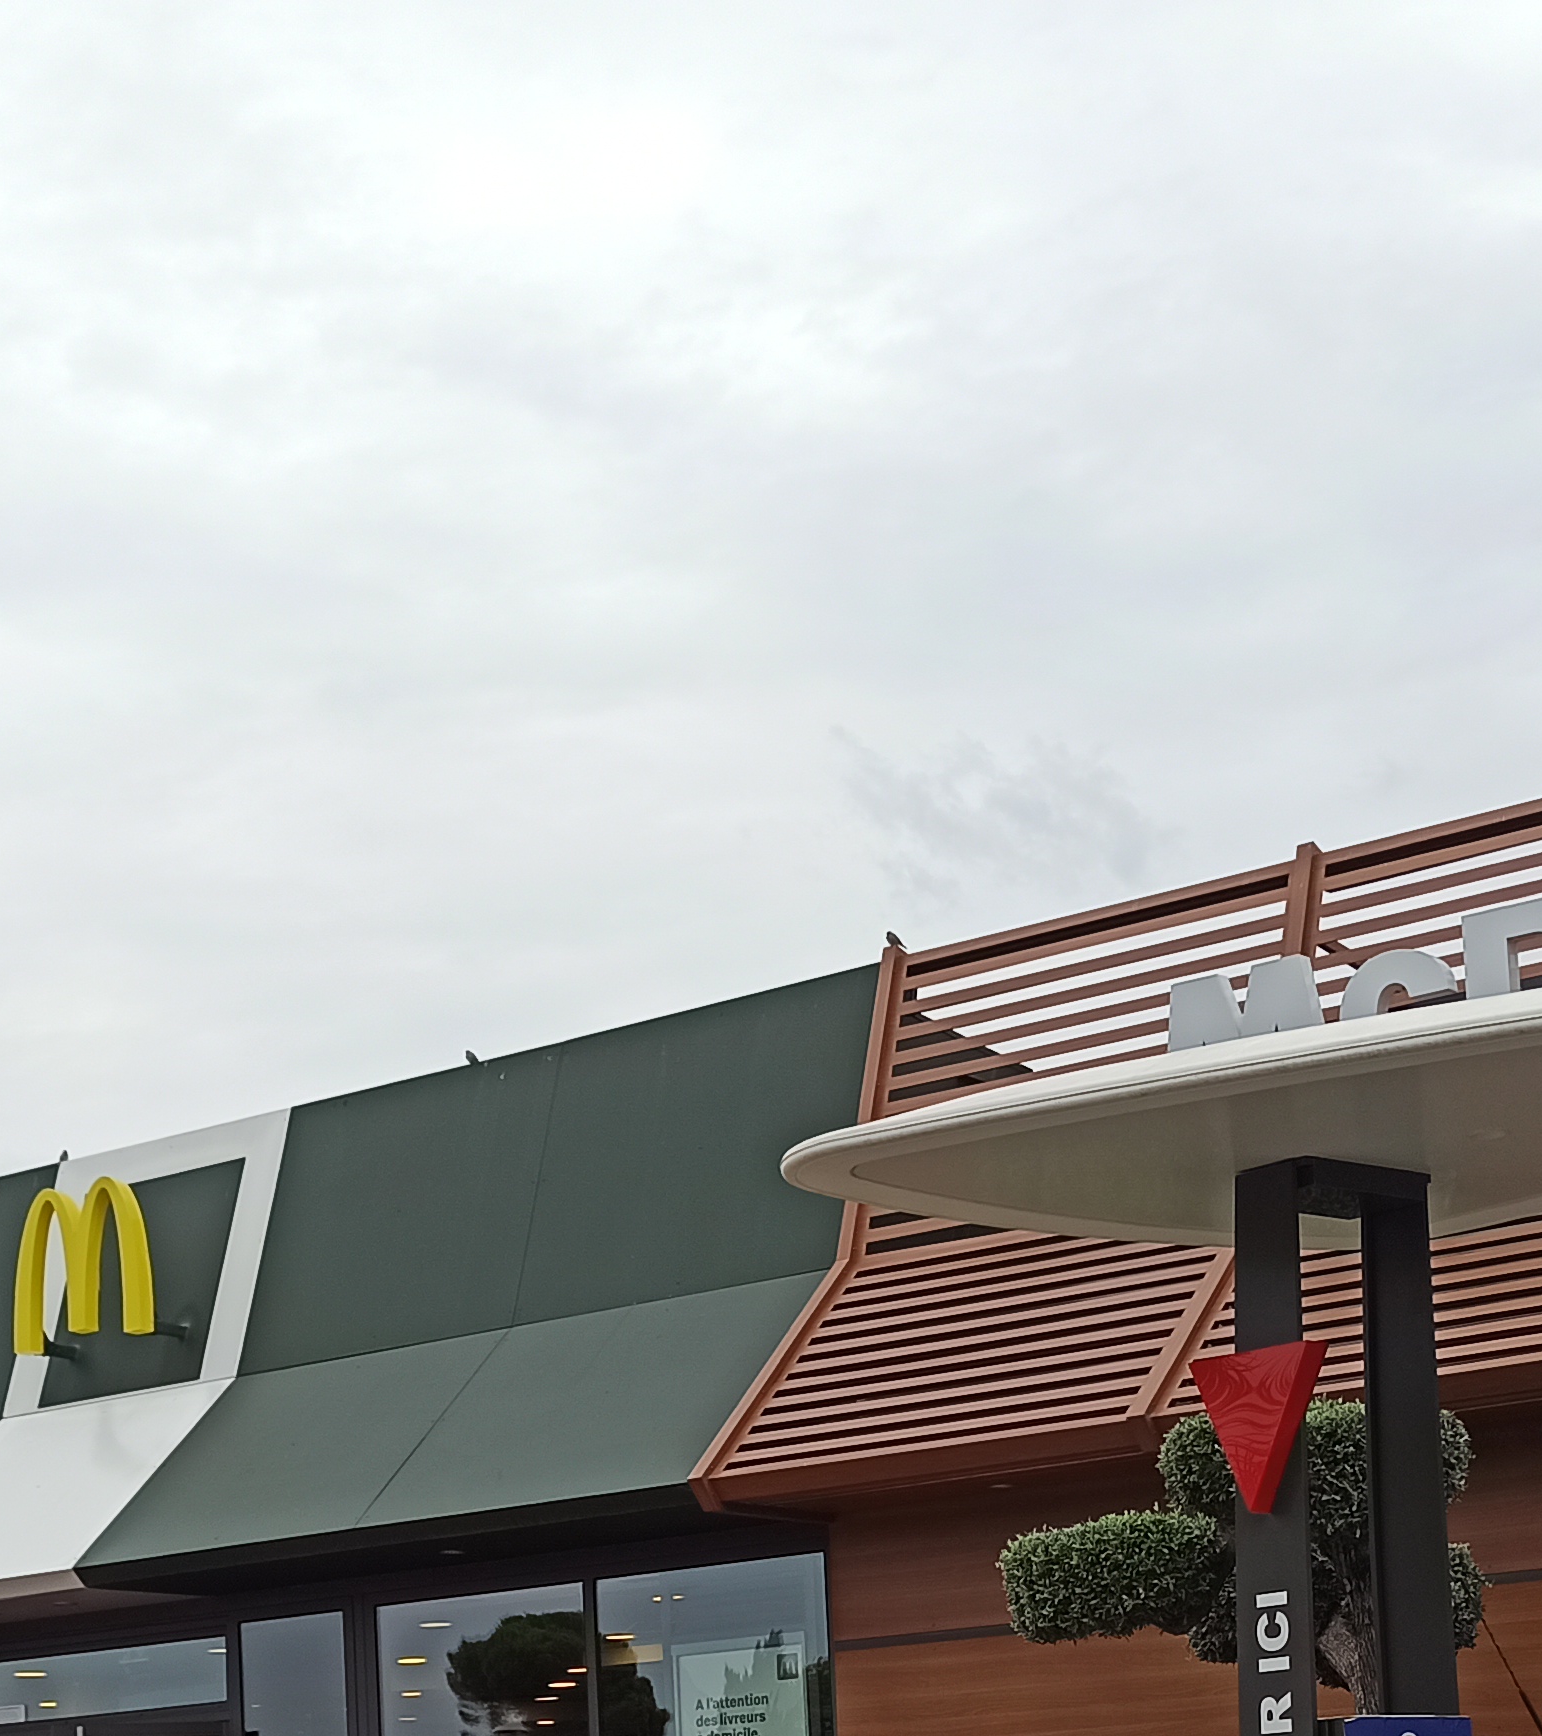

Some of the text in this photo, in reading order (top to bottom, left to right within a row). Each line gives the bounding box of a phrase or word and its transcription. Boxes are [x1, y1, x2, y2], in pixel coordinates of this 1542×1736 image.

[1255, 1590, 1290, 1673] ICI
[706, 1693, 769, 1710] l'attention
[696, 1711, 766, 1727] des livreurs
